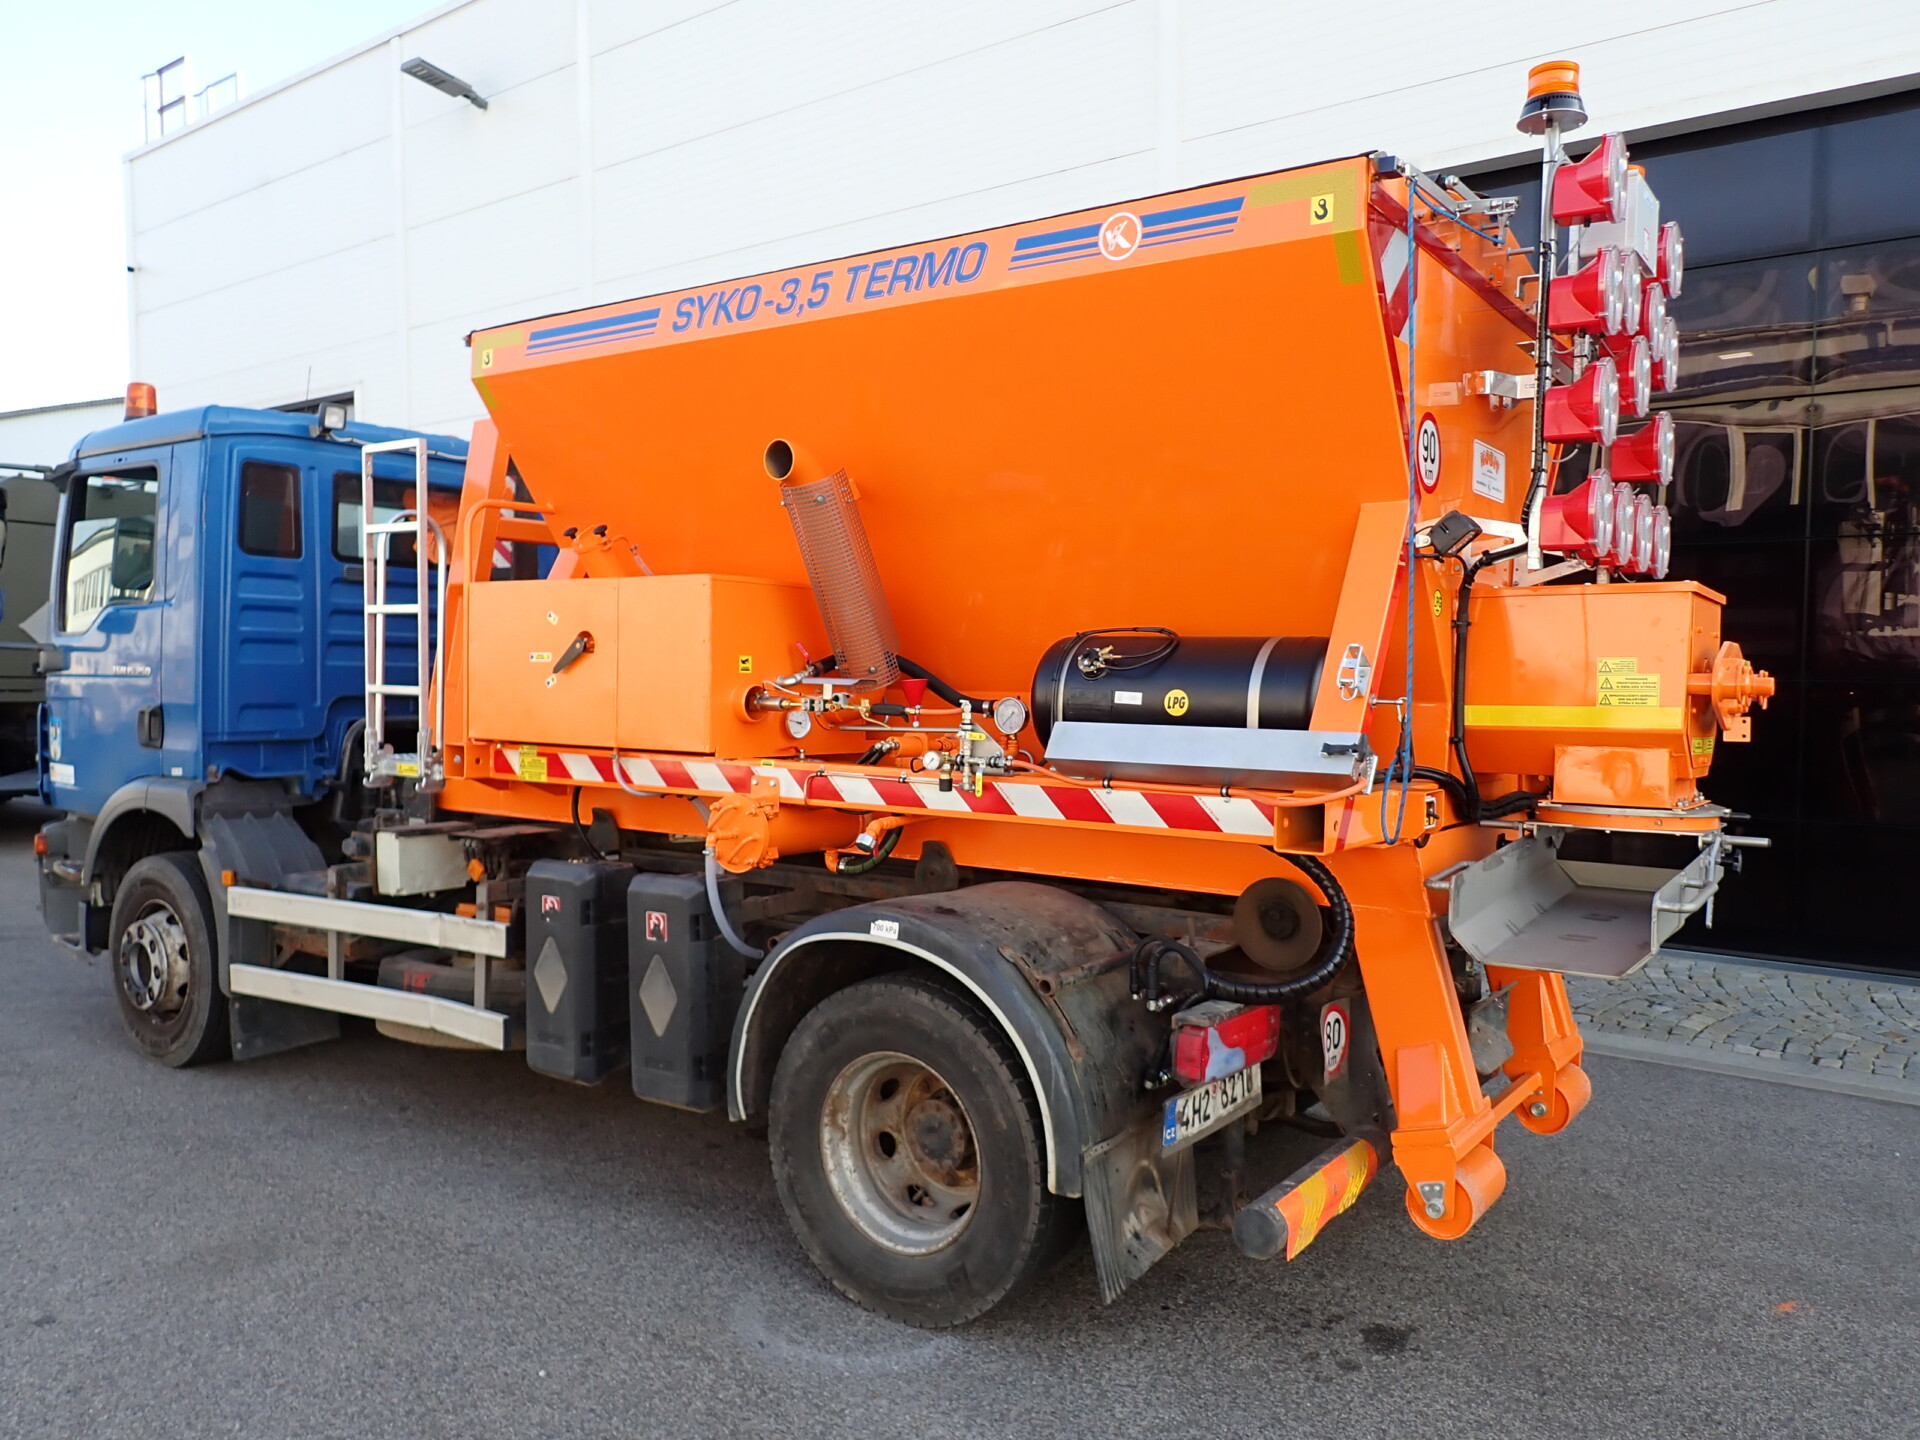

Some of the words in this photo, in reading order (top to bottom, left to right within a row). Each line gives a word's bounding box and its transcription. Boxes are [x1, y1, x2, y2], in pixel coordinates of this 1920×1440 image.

[672, 270, 834, 333] SYKO-3,5
[845, 241, 988, 303] TERMO
[1422, 428, 1436, 465] 90
[1424, 465, 1434, 481] km
[1167, 696, 1186, 710] LPG
[1325, 1017, 1341, 1053] 80
[1327, 1055, 1337, 1067] km
[1180, 1089, 1210, 1131] 4H2
[1166, 1127, 1176, 1140] CZ
